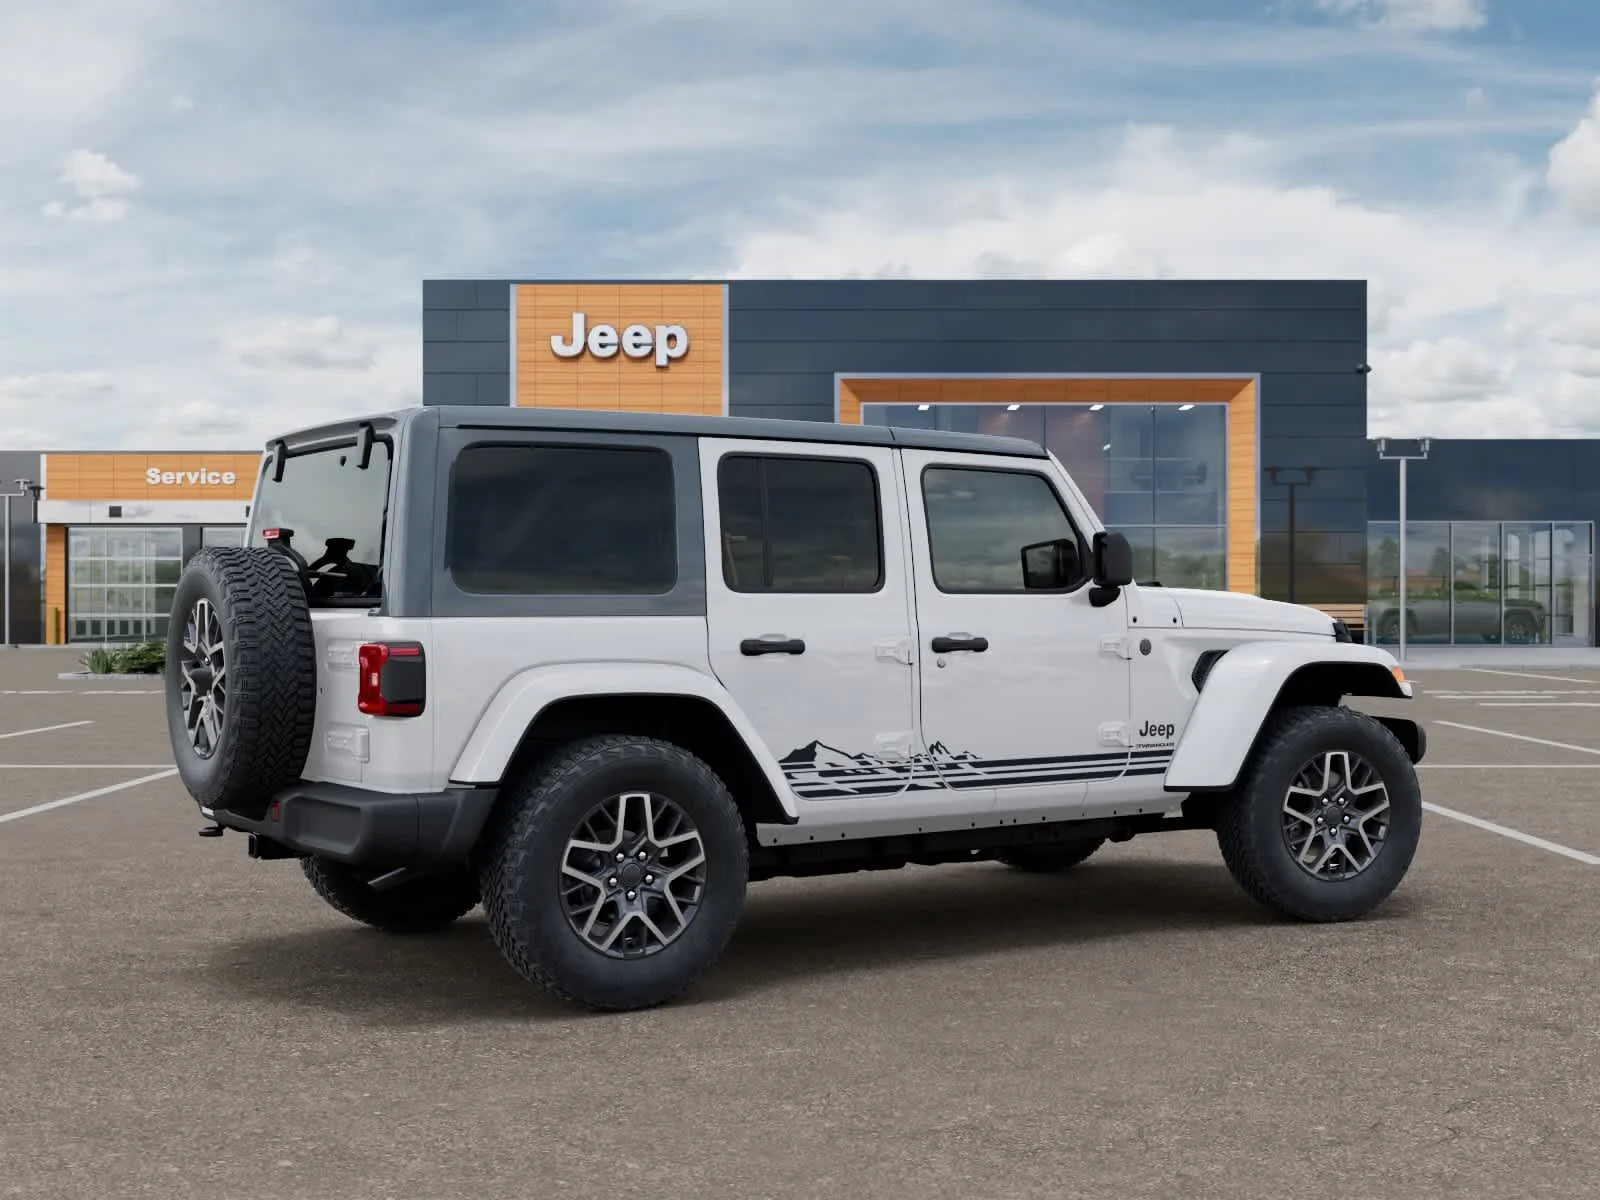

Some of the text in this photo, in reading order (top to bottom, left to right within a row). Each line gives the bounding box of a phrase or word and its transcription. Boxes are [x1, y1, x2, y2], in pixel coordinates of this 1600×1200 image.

[550, 311, 689, 367] Jeep
[146, 466, 236, 486] Service
[1139, 720, 1175, 740] Jeep
